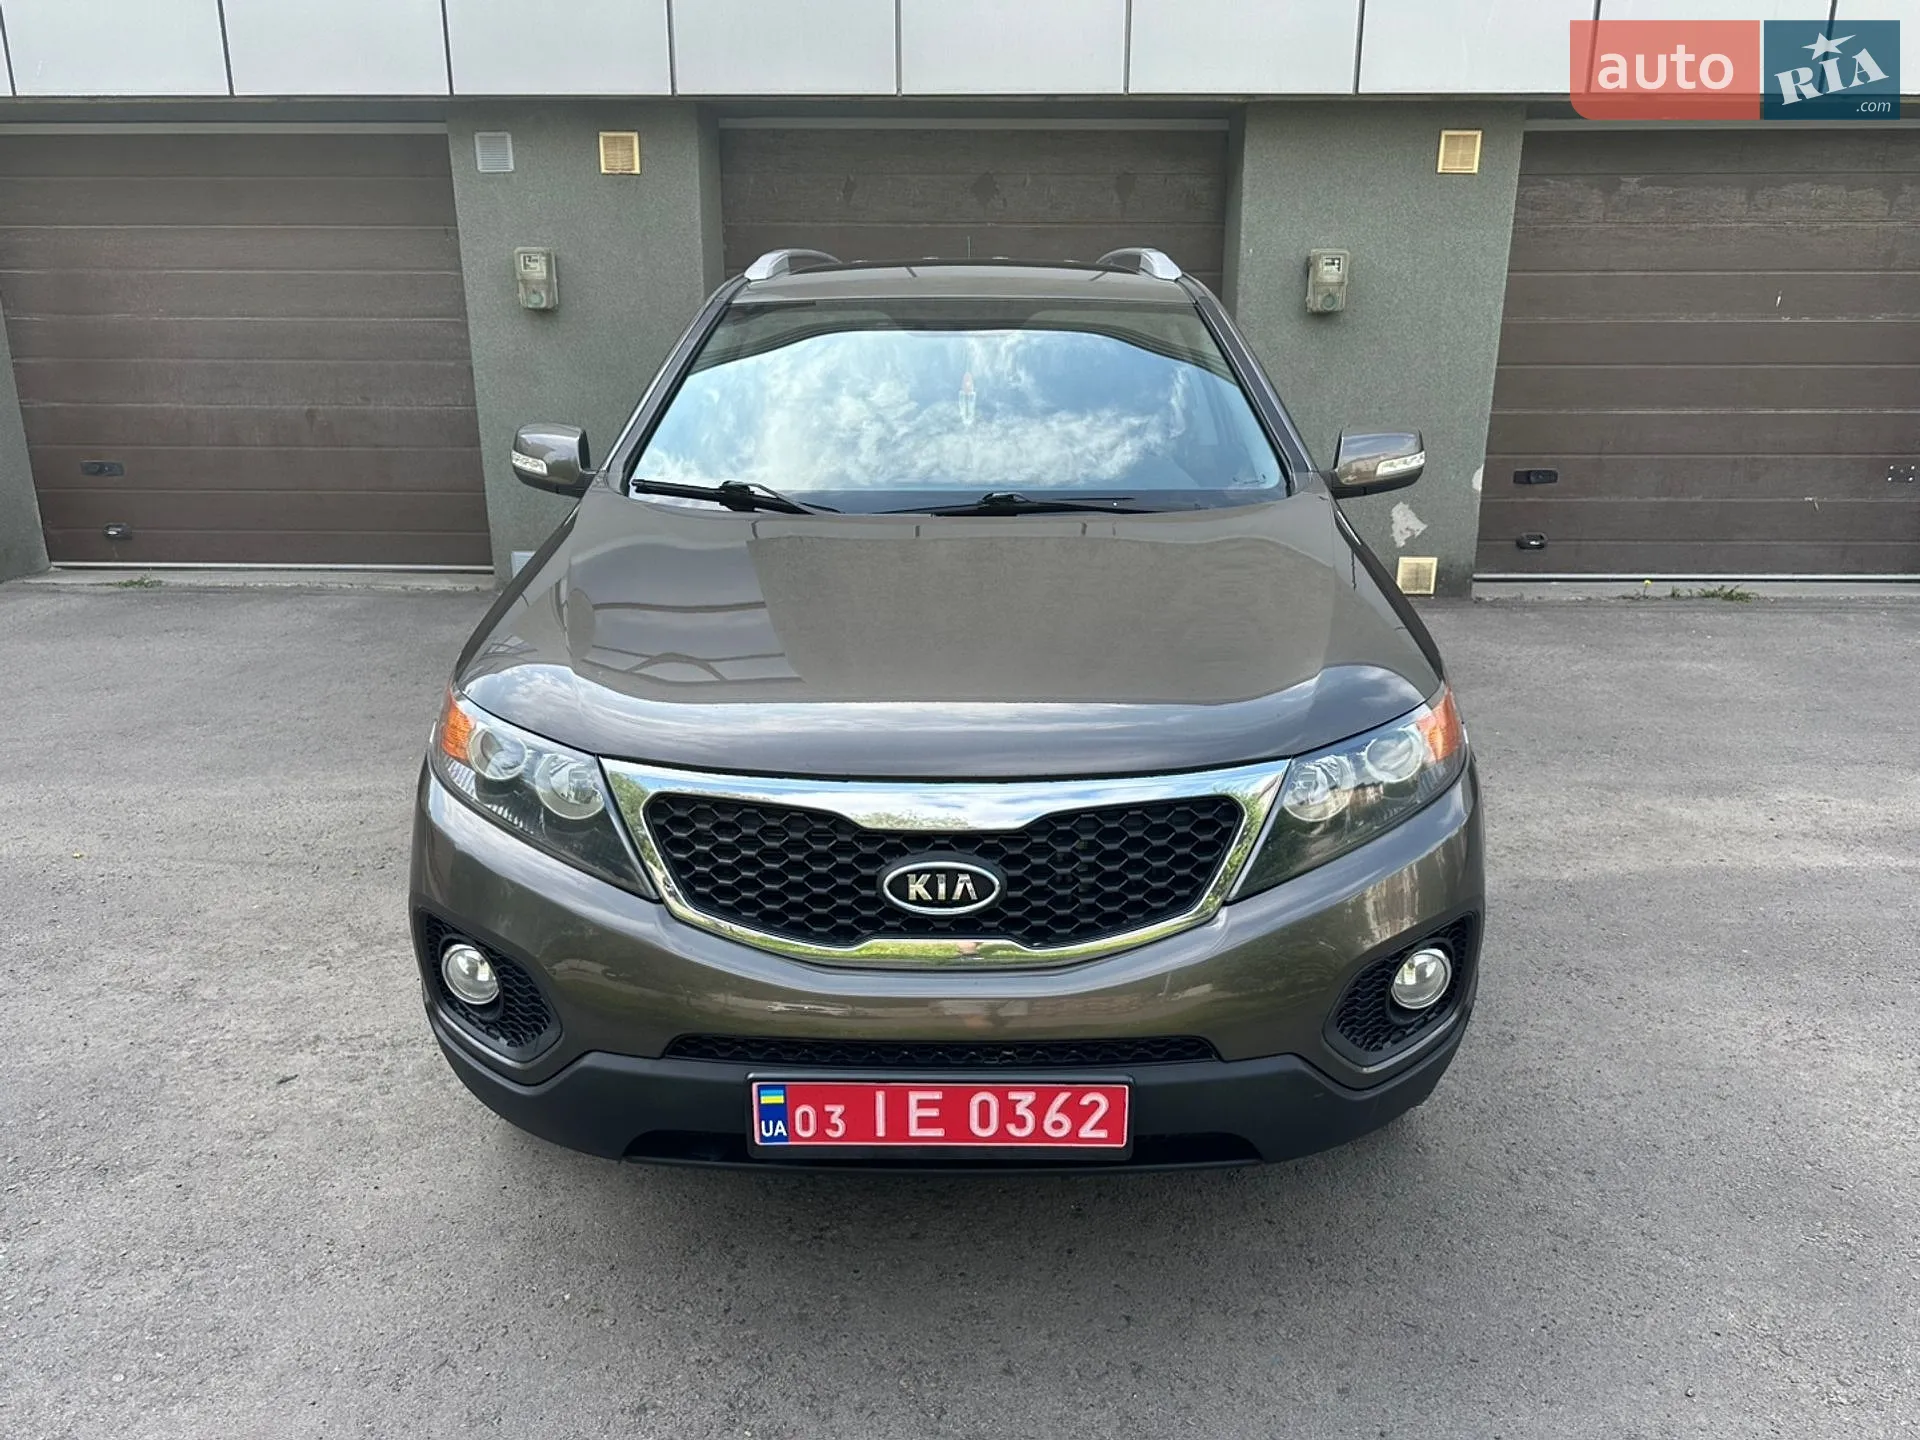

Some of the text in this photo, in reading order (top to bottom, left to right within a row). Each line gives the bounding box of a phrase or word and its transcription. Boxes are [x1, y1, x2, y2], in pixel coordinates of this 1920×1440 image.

[906, 873, 978, 900] KIA
[761, 1120, 787, 1137] UA
[794, 1104, 847, 1138] 03
[969, 1091, 1110, 1139] 0362
